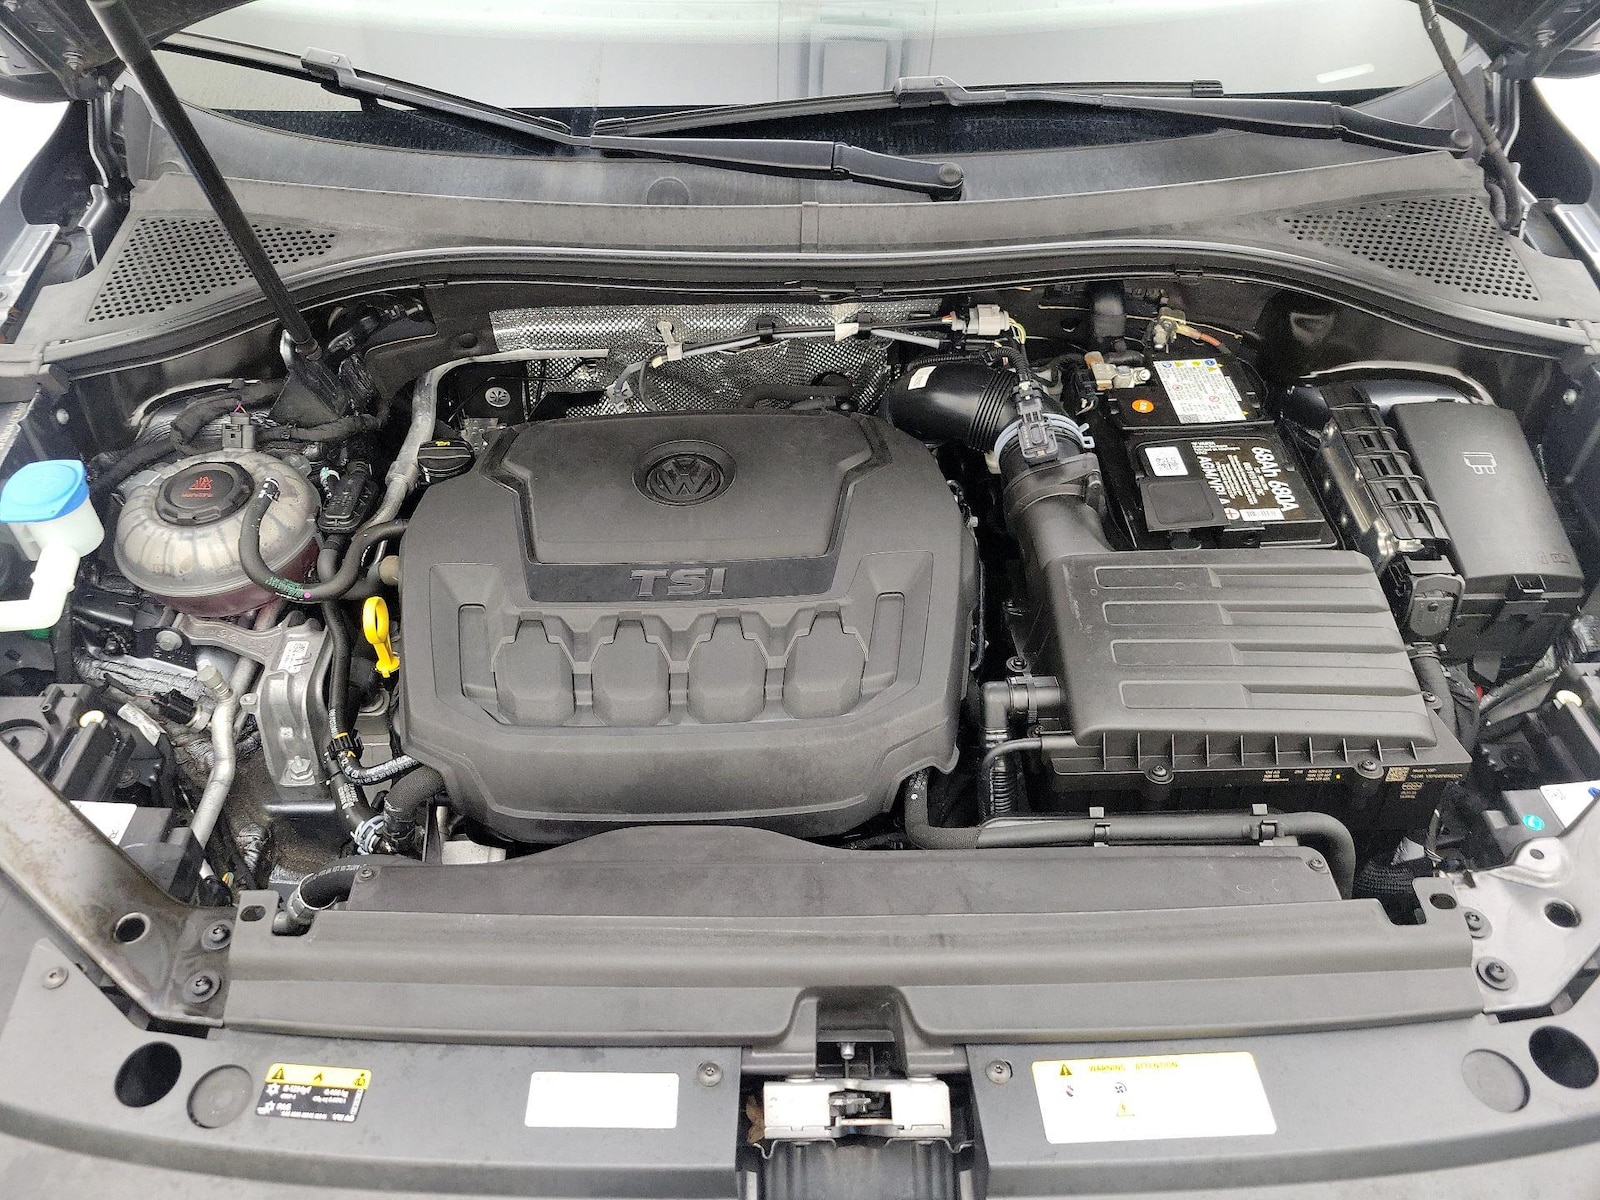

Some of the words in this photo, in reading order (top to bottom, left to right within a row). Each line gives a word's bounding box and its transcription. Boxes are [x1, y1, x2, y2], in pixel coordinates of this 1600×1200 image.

[1252, 447, 1281, 478] 68Ah
[1267, 480, 1300, 512] 680A
[630, 567, 728, 597] TSI
